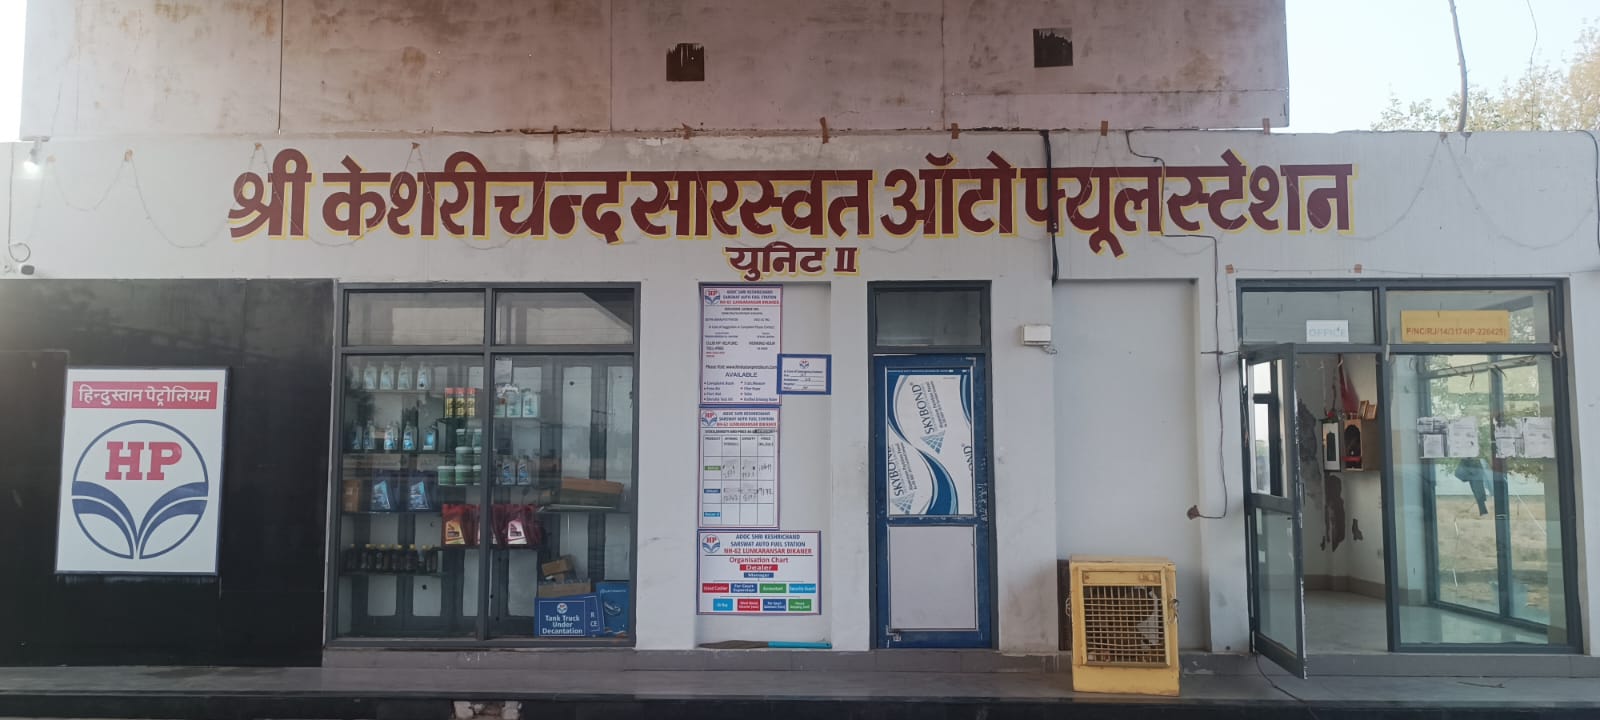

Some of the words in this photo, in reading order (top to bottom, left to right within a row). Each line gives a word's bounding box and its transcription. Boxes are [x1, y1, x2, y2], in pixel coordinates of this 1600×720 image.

[228, 148, 313, 240] श्री
[321, 150, 627, 244] केशरीचन्द
[630, 170, 874, 239] सारस्वत
[880, 150, 1016, 238] ऑटो
[1165, 148, 1354, 234] स्टेशन
[724, 240, 828, 282] युनिट
[78, 384, 144, 405] हिन्दुस्तान
[146, 385, 211, 406] पेट्रोलियम
[911, 384, 935, 434] SKYBOND
[105, 441, 182, 480] HP
